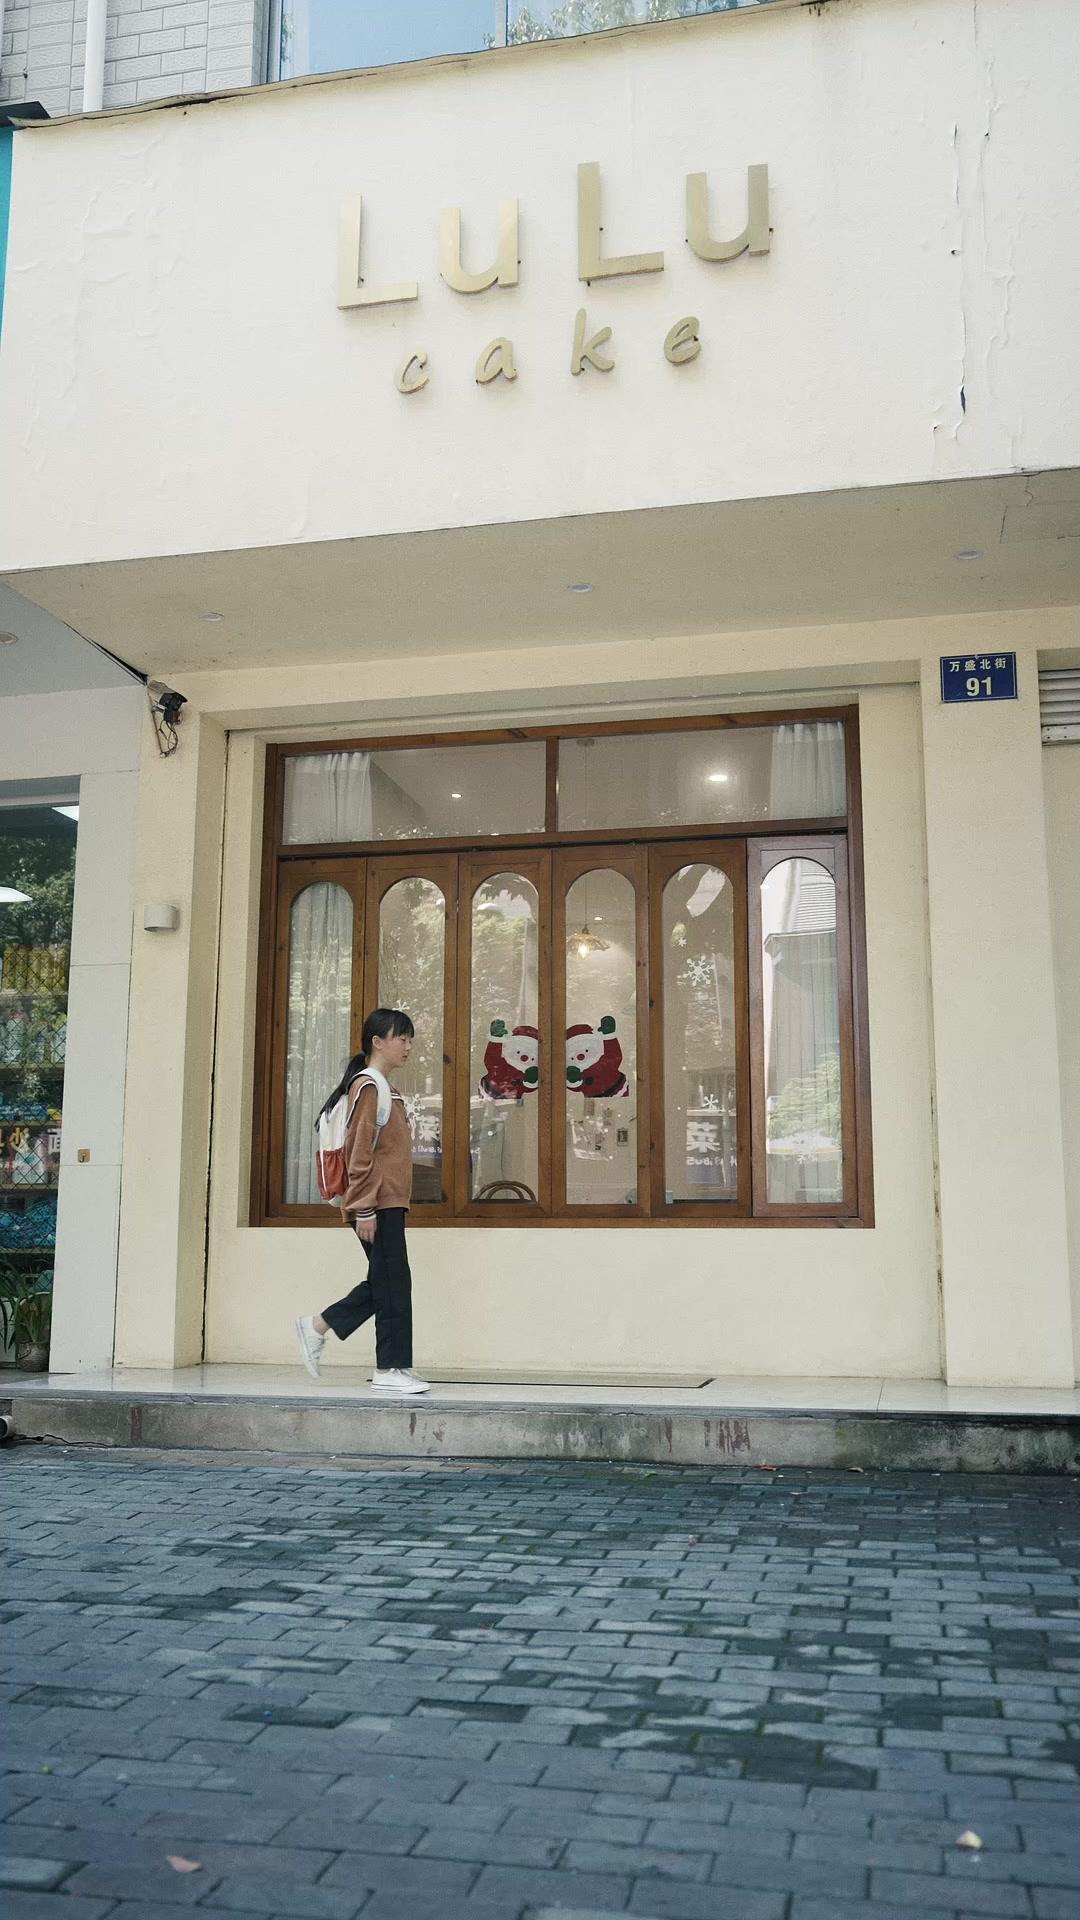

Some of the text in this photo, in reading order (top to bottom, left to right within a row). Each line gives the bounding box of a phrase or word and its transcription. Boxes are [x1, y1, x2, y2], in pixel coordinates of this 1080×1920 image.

[395, 308, 701, 394] cake
[949, 658, 1006, 672] 万盛北街
[966, 676, 992, 696] 91
